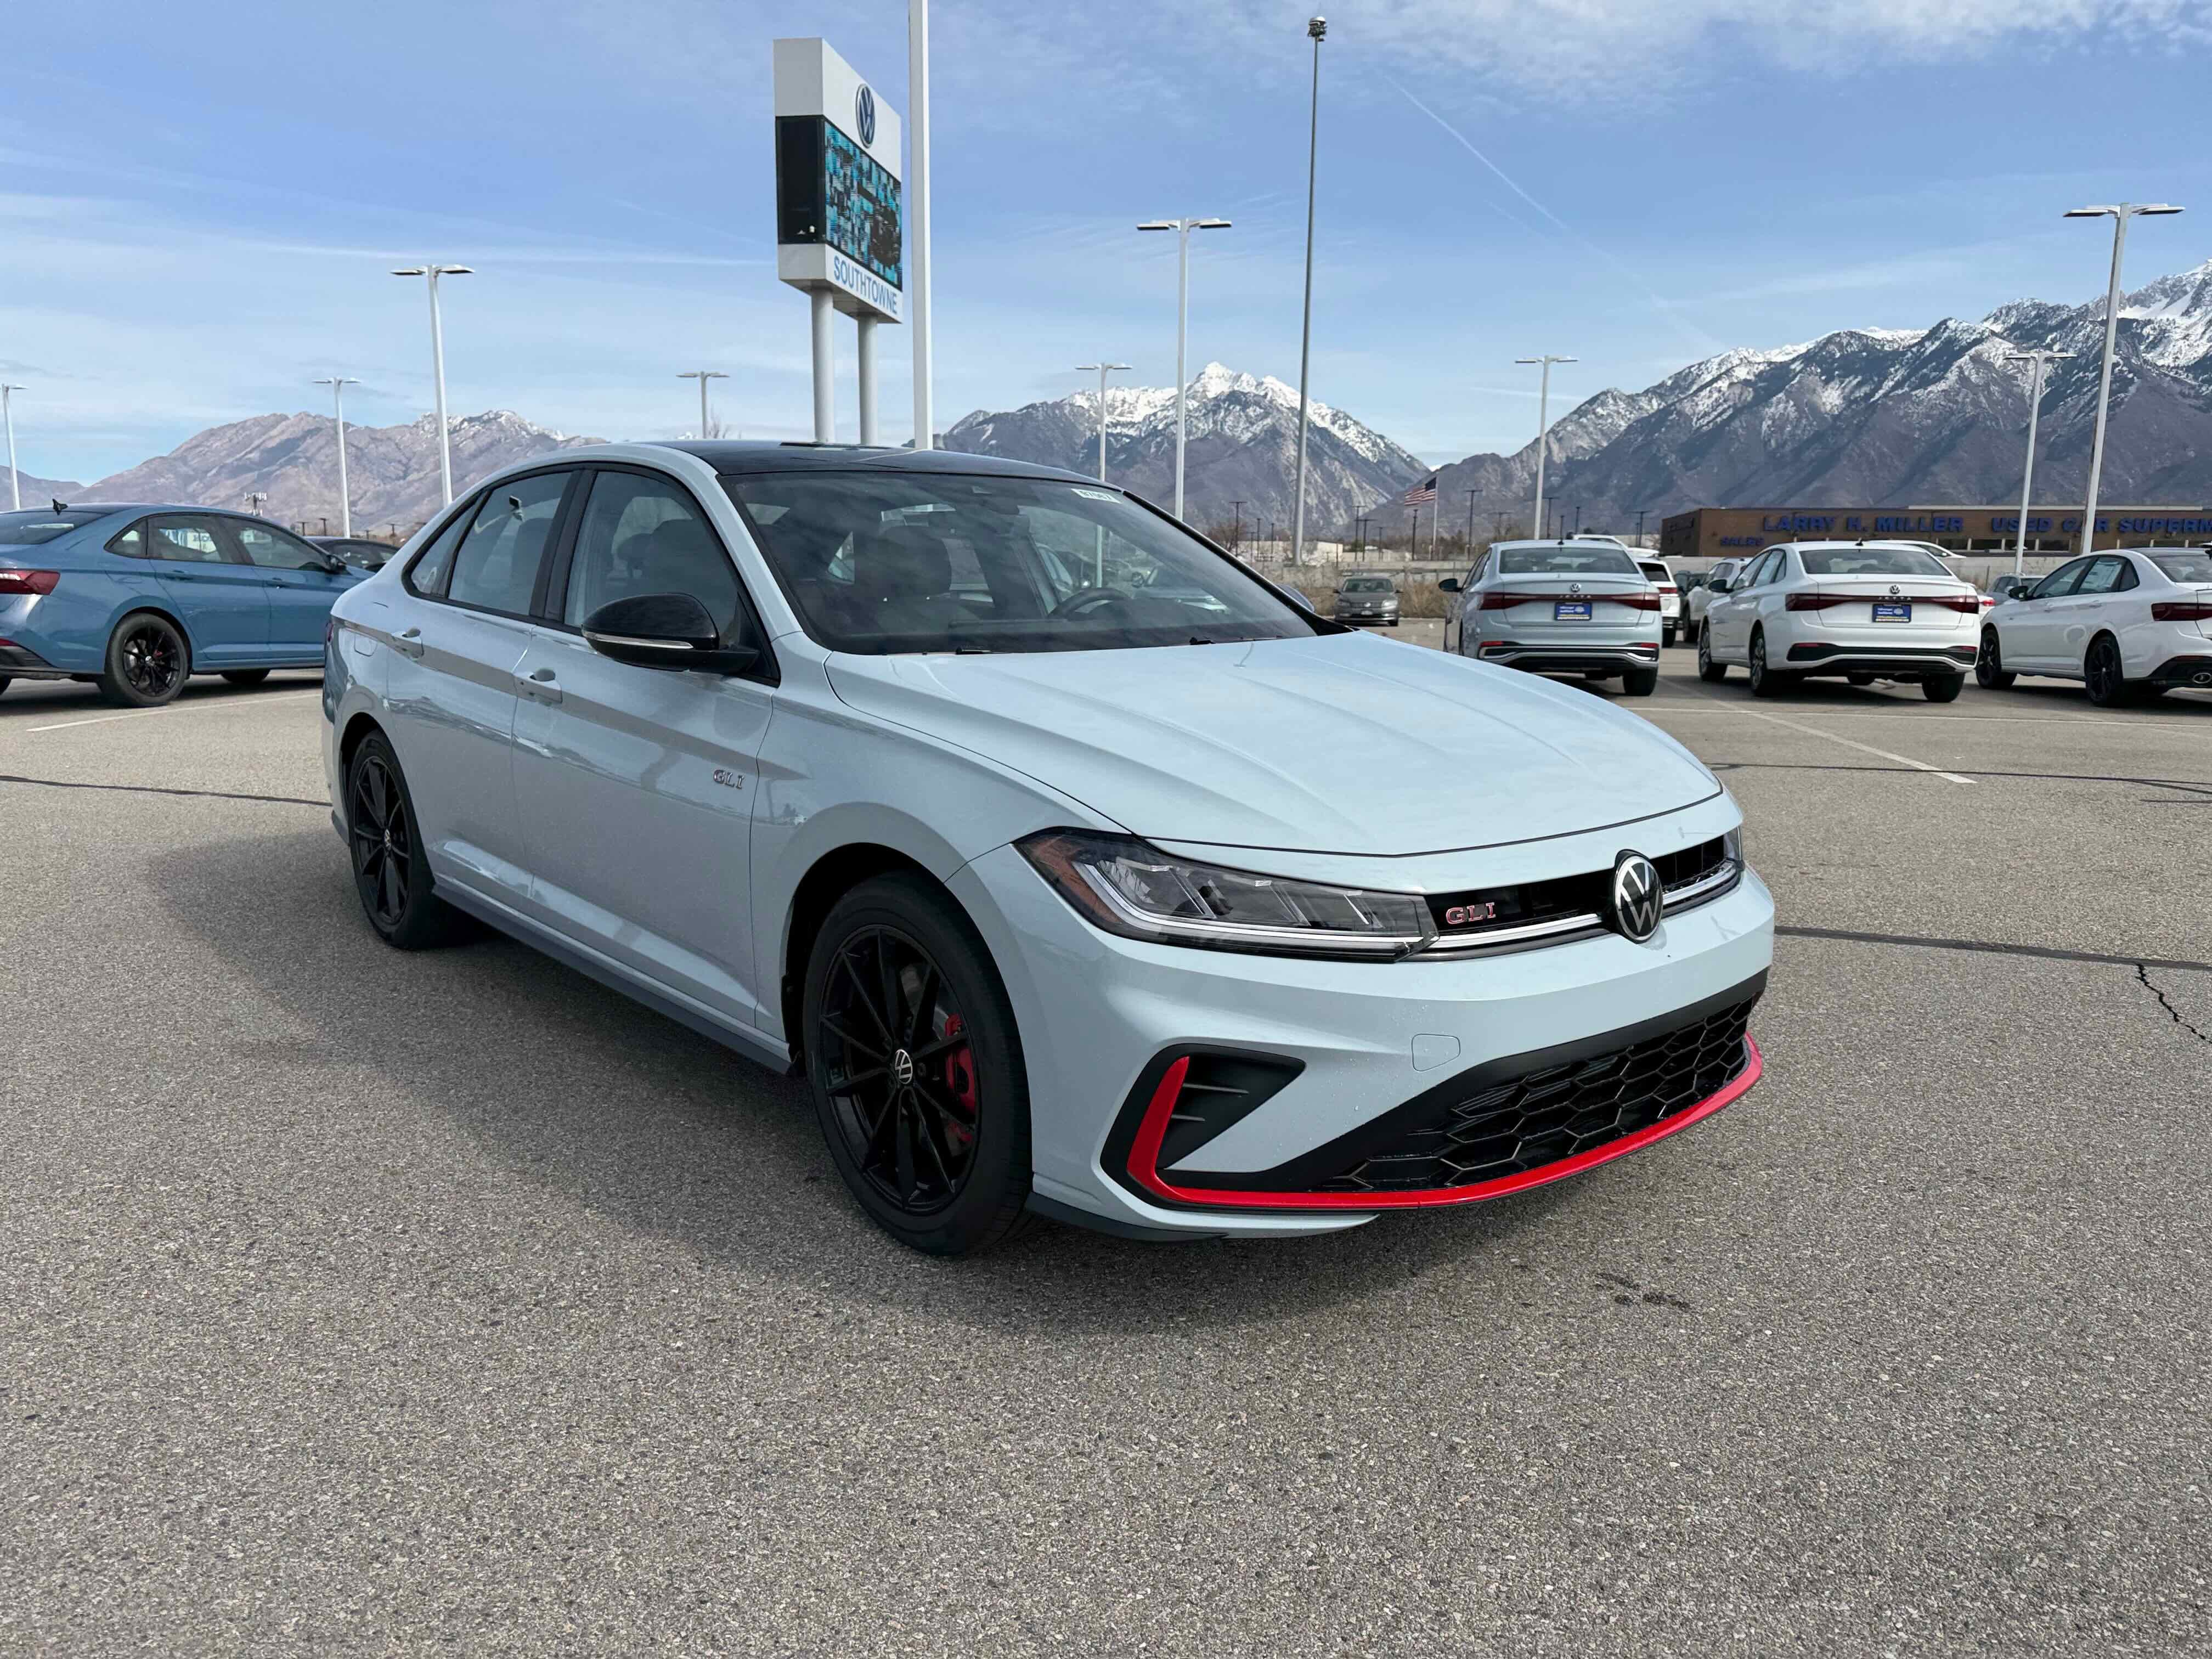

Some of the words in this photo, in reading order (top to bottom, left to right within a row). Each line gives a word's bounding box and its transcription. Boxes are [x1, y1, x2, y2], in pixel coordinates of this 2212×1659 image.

[834, 255, 898, 314] SOUTHTOWNE
[1764, 517, 1835, 531] LARRY
[1875, 517, 1963, 532] MILLER
[1992, 517, 2052, 532] USED
[2062, 517, 2108, 532] CR
[713, 769, 744, 789] GLI
[1446, 902, 1496, 924] GLI
